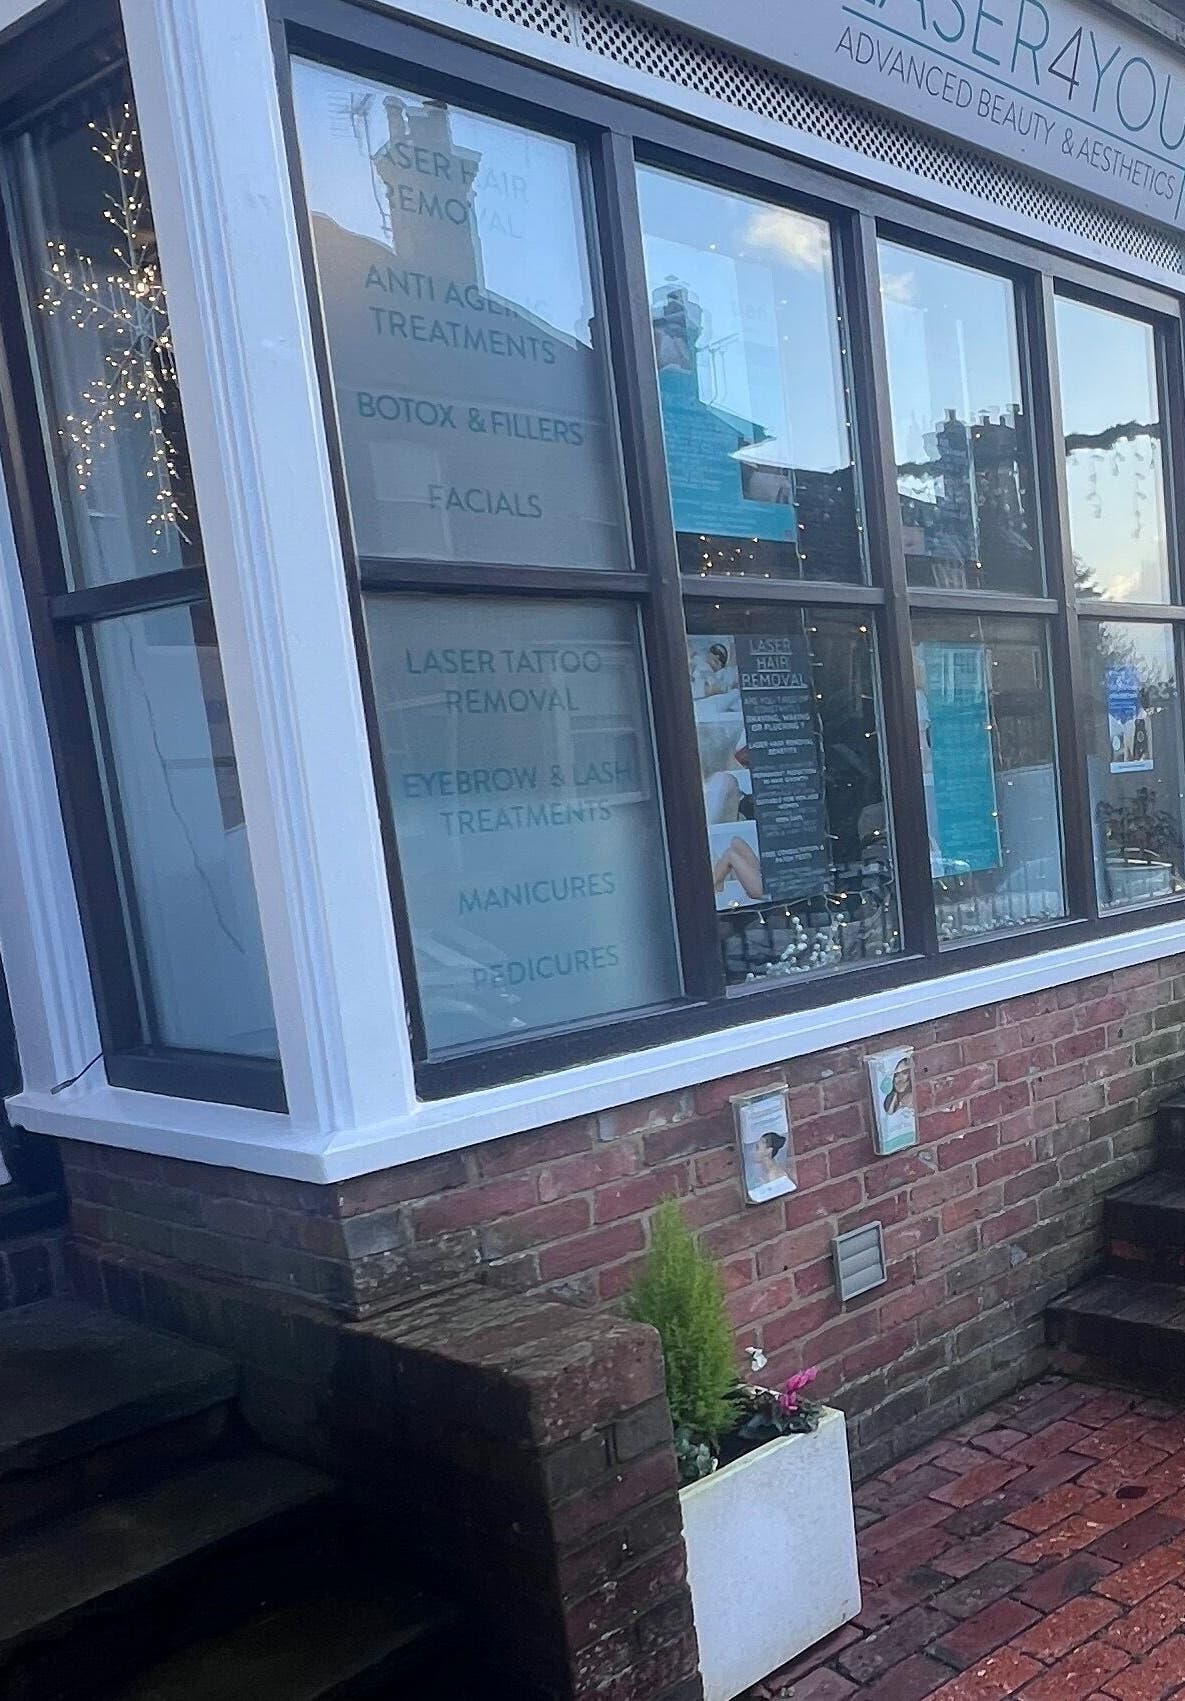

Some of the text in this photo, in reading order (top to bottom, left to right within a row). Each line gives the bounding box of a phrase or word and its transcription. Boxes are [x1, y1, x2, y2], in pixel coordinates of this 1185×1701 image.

[835, 26, 1177, 200] ADVANCED BEAUTY & AESTHETICS
[364, 262, 435, 303] ANTI
[369, 305, 557, 364] TREATMENTS
[358, 391, 584, 447] BOTOX & FILLERS
[428, 484, 542, 518] FACIALS
[406, 648, 601, 675] LASER TATTOO
[742, 672, 808, 688] REMOVAL
[757, 656, 789, 670] HAIR
[445, 687, 580, 715] REMOVAL
[402, 761, 633, 798] EYEBROW & LASH
[440, 801, 612, 837] TREATMENTS
[458, 872, 617, 915] MANICURES
[472, 945, 620, 989] PEDICURES
